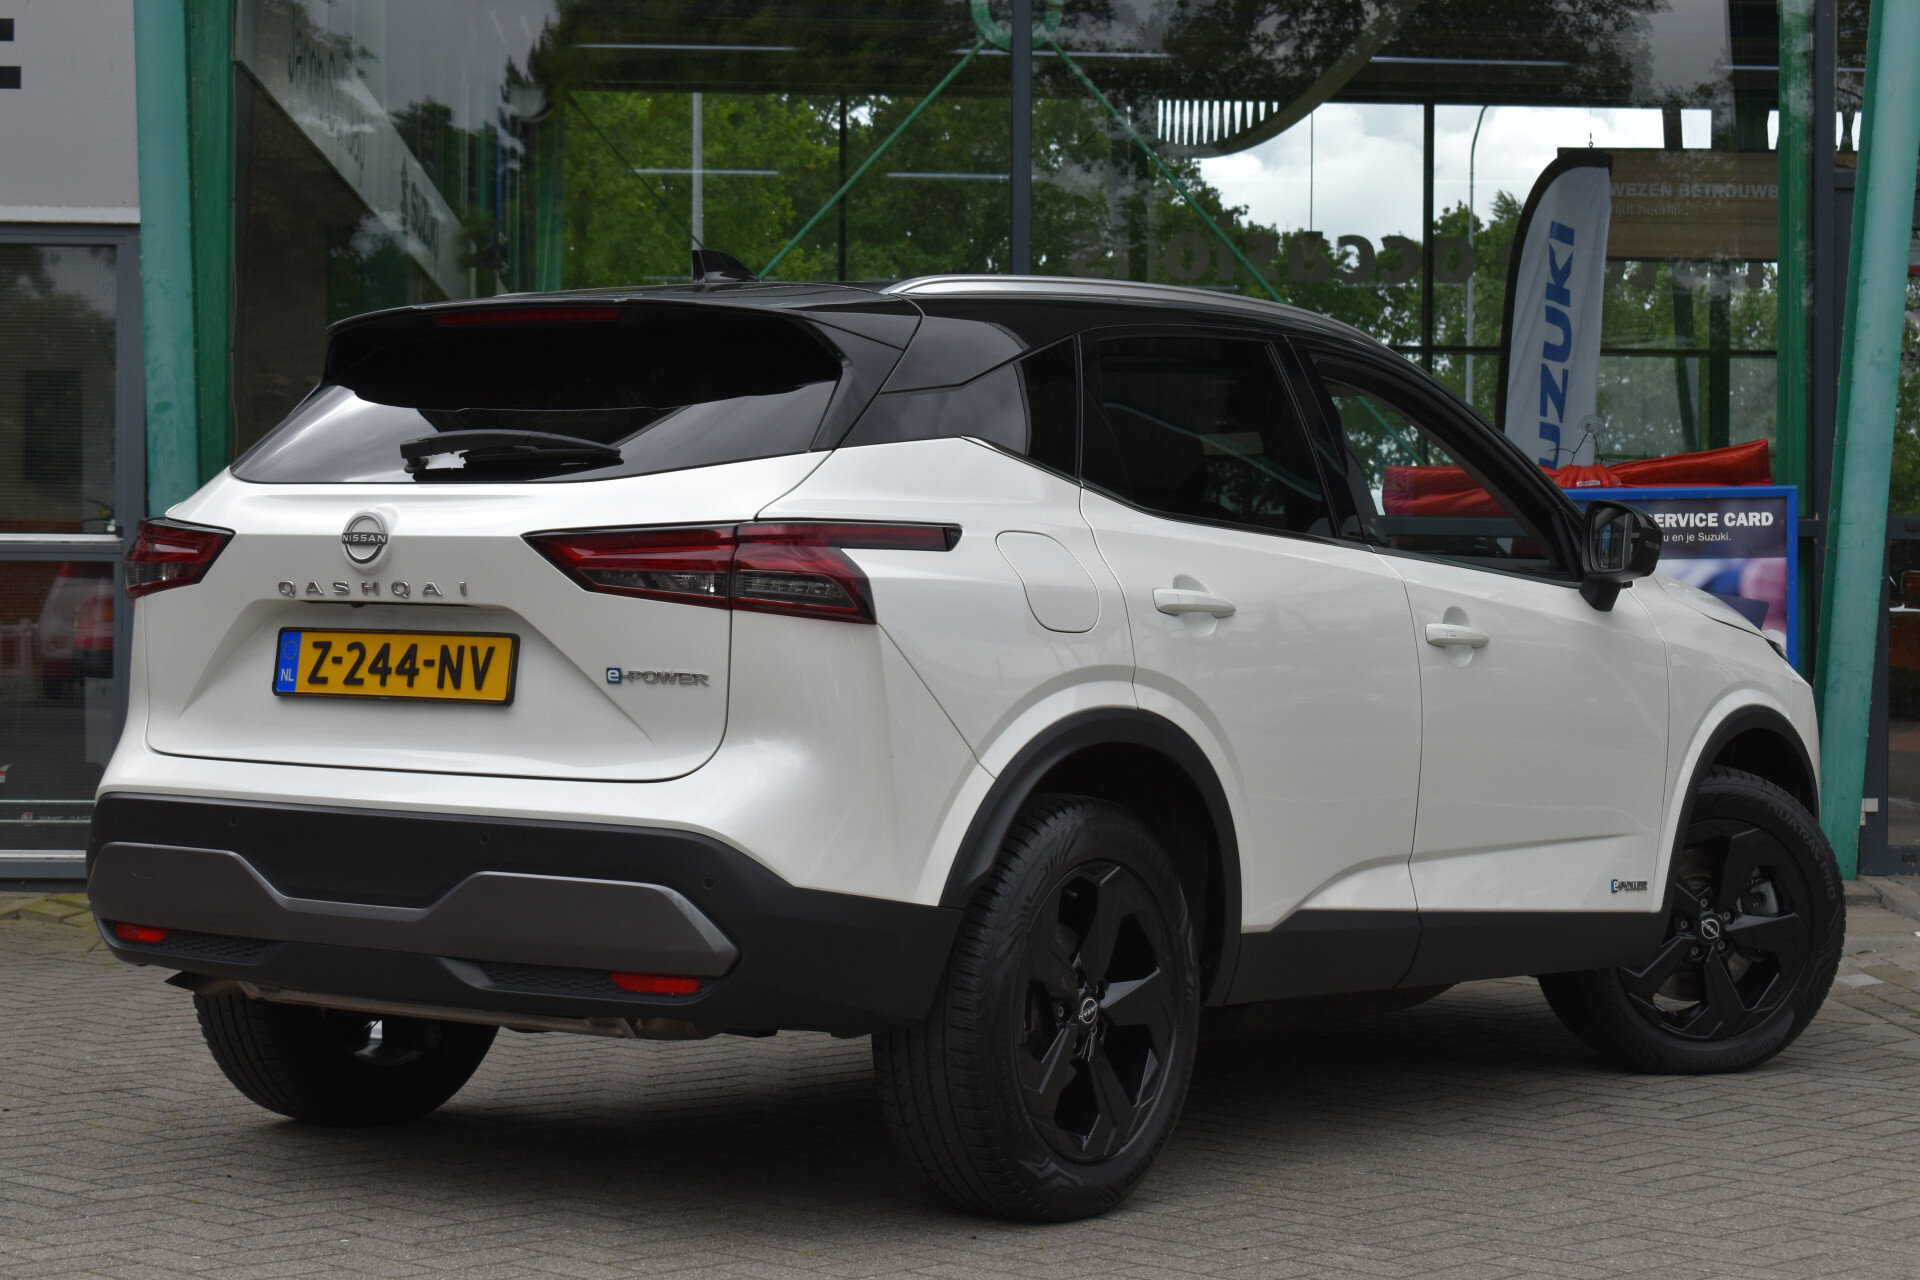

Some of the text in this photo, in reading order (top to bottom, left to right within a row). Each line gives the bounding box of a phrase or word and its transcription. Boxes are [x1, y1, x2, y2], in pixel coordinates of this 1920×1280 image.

[1649, 511, 1774, 528] ERVICE CARD
[341, 532, 387, 545] NISSAN
[1672, 534, 1684, 542] en
[1685, 532, 1695, 543] je
[1698, 532, 1732, 542] Suzuki.
[278, 580, 468, 597] QASHQAI
[306, 640, 496, 691] Z-244-NV
[281, 668, 294, 682] NL
[606, 666, 710, 687] e-POWER
